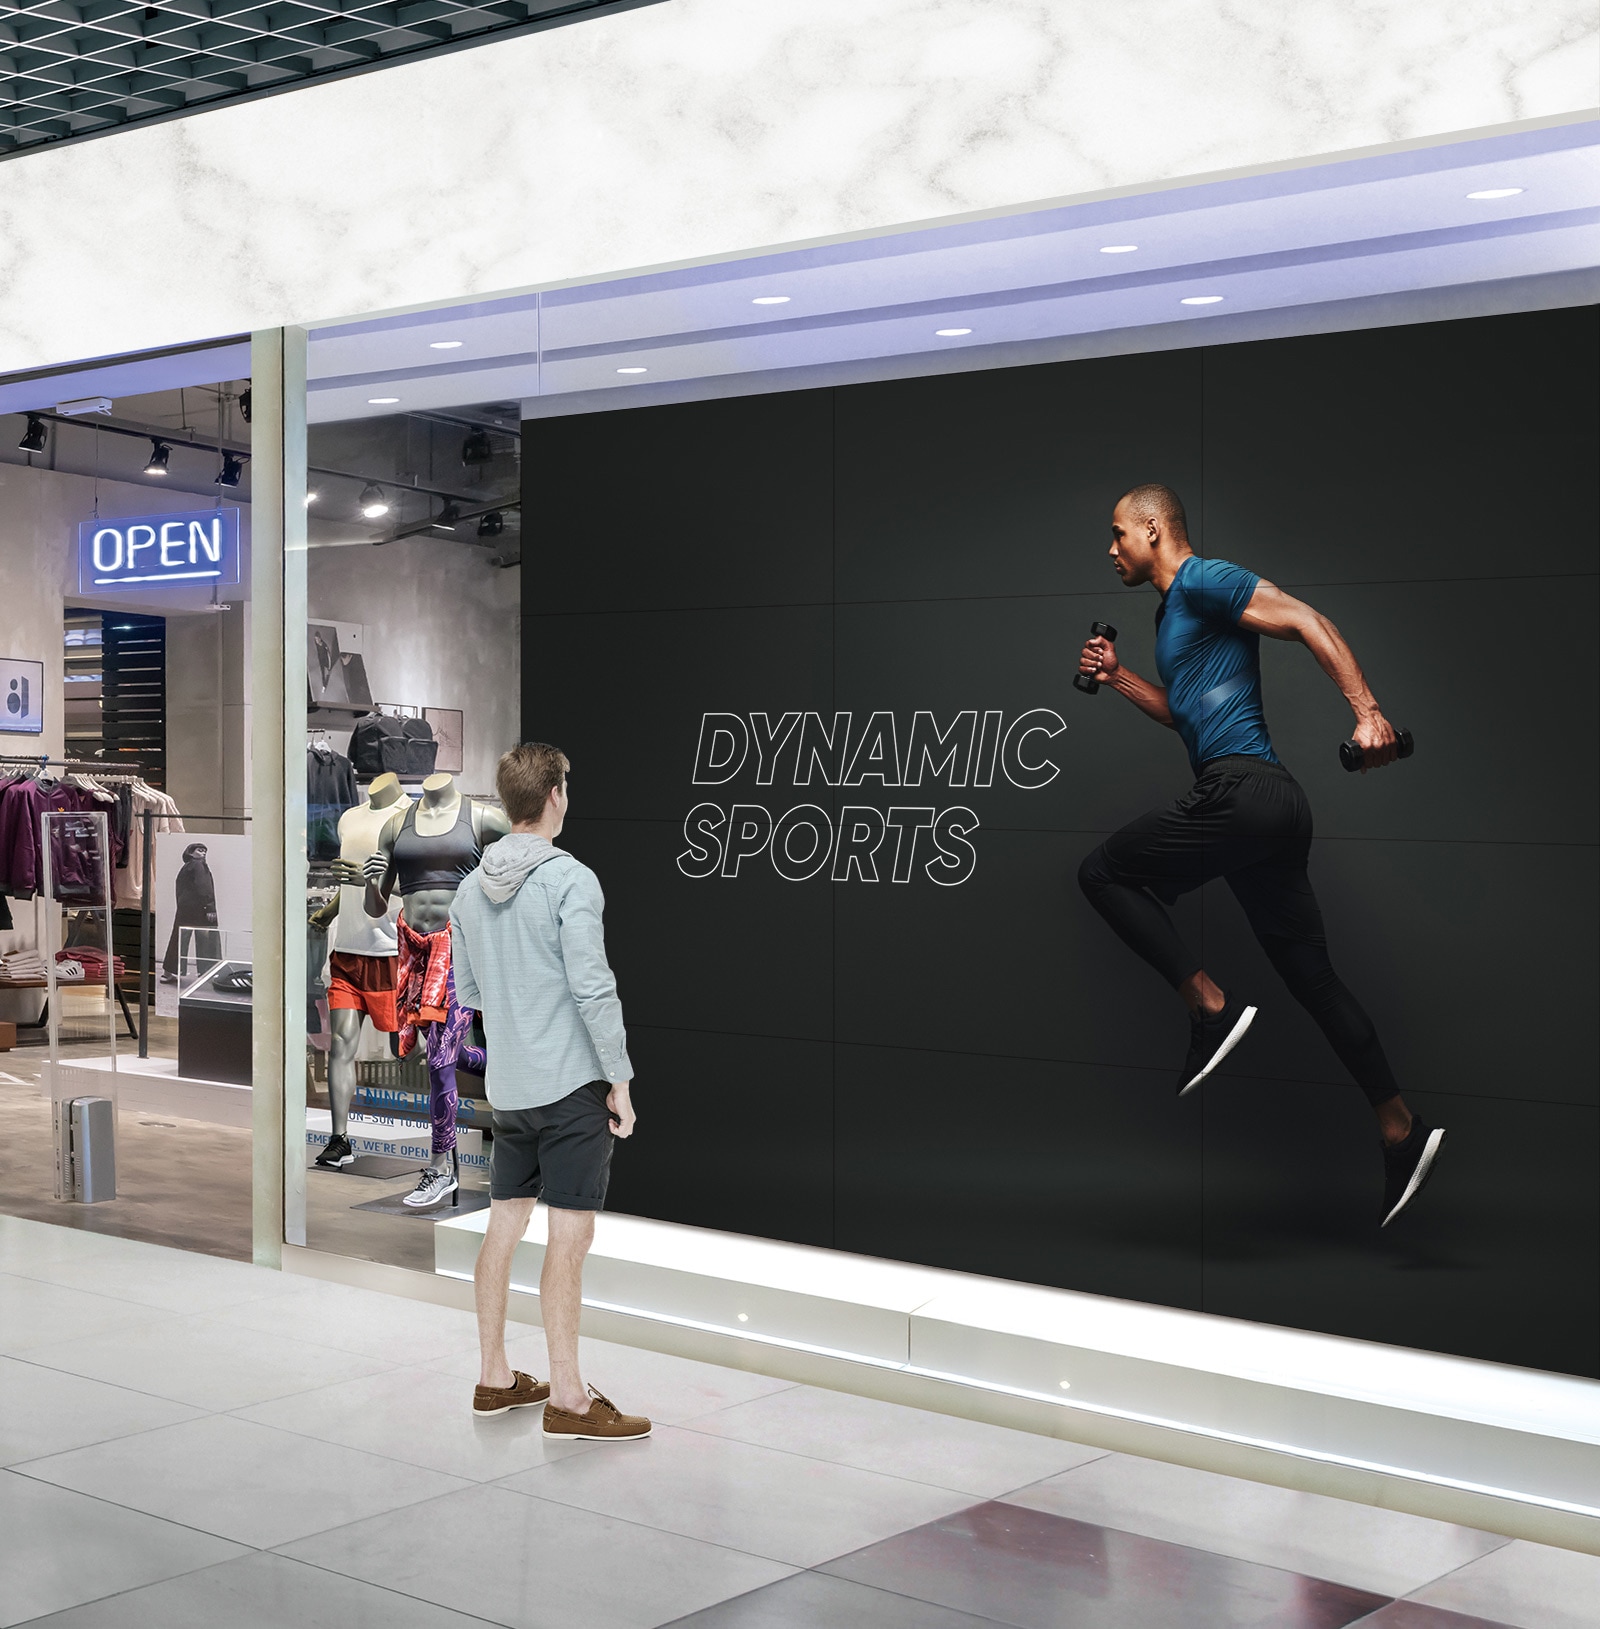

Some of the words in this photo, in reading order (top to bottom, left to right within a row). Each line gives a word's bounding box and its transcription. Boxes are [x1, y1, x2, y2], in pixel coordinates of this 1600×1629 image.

[93, 518, 220, 571] OPEN
[692, 708, 1067, 789] DYNAMIC
[676, 803, 980, 886] SPORTS
[355, 1086, 409, 1109] ENING
[348, 1111, 394, 1125] ON-SUN
[363, 1141, 396, 1154] WE'RE
[400, 1145, 429, 1158] OPEN
